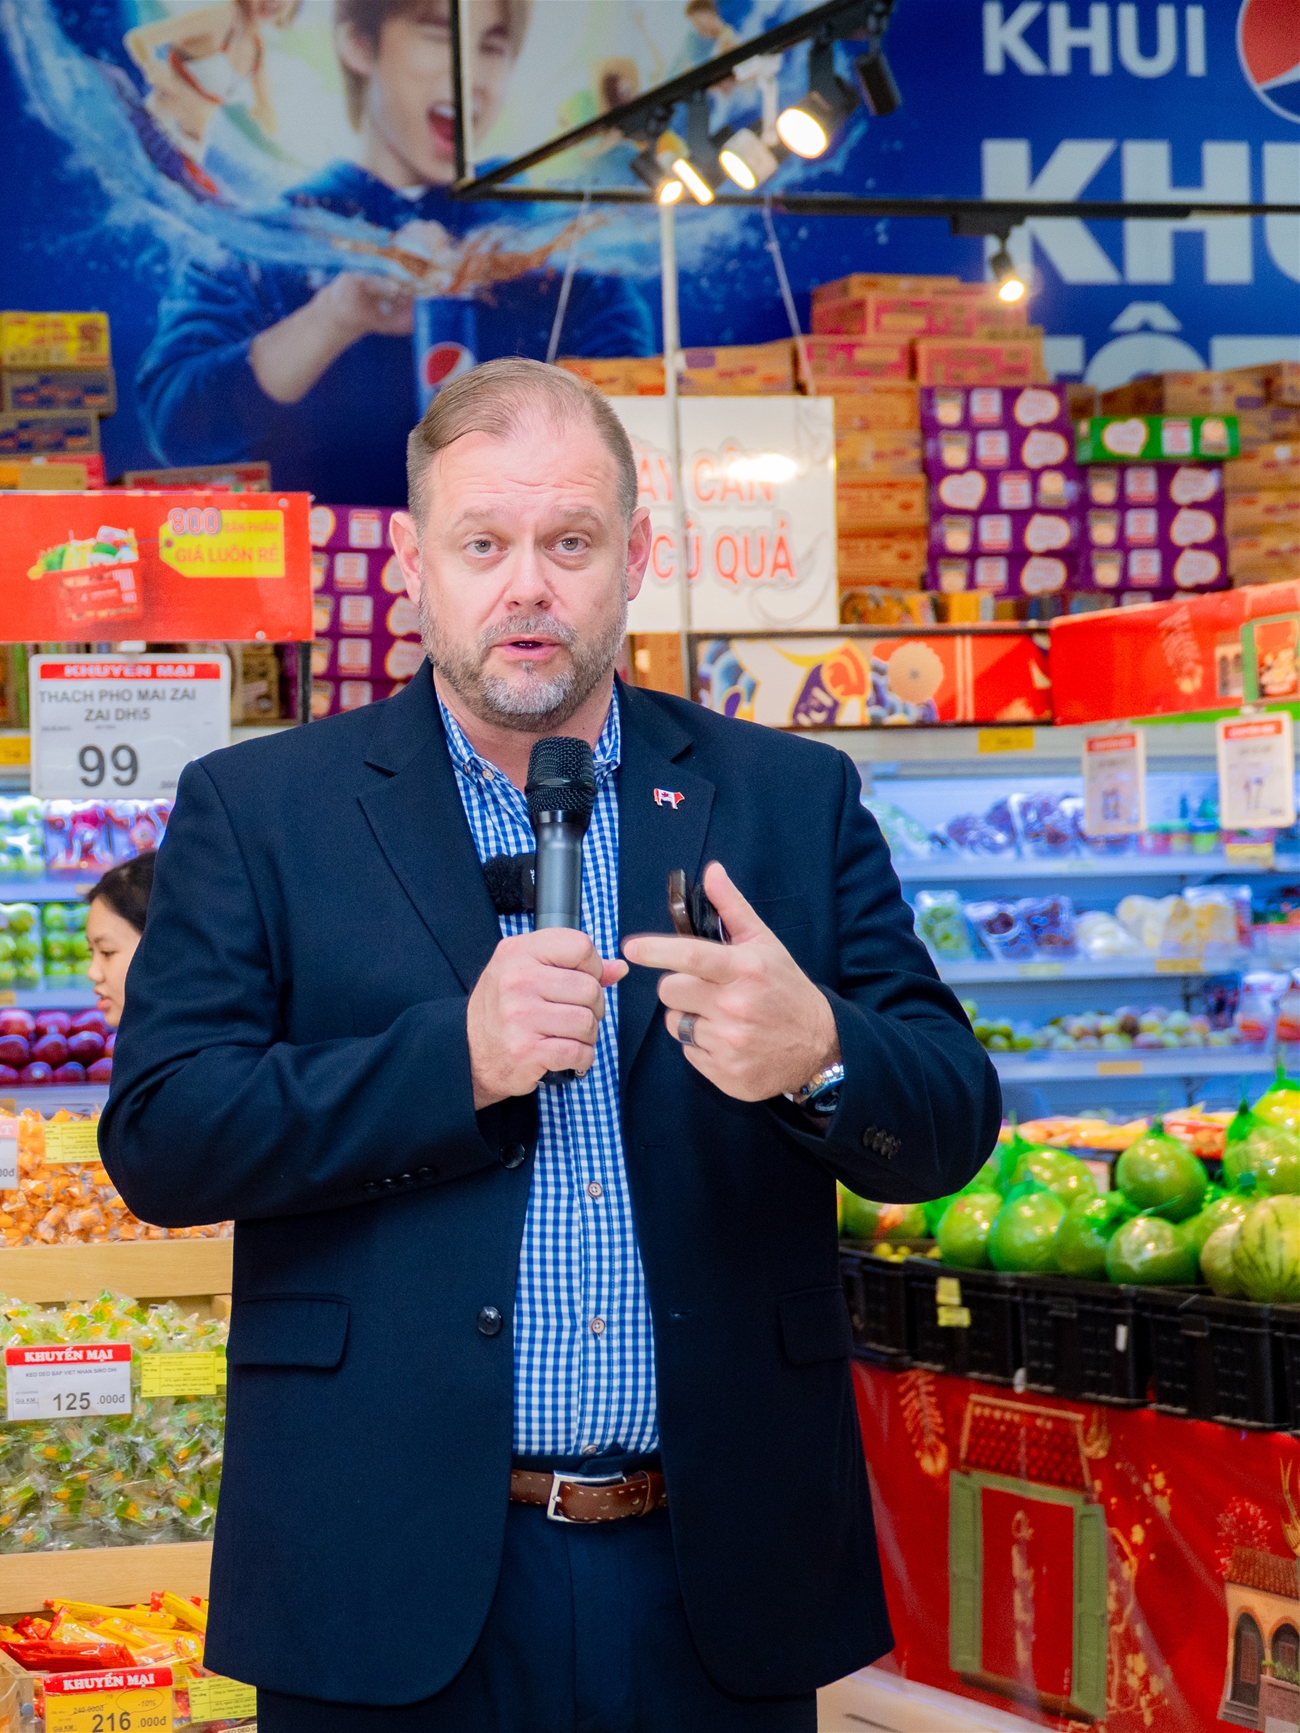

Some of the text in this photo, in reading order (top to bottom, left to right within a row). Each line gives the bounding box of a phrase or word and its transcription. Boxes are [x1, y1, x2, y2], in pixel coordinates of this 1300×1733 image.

[982, 3, 1207, 78] KHUI
[168, 507, 222, 536] 800
[174, 544, 205, 564] GIÁ
[208, 545, 254, 564] LUÔN
[714, 518, 796, 585] QUẢ
[39, 687, 197, 703] THACH PHO MAI ZAI
[84, 708, 111, 722] ZAI
[77, 743, 140, 788] 99
[24, 1347, 114, 1363] KHUYẾN MẠI
[52, 1391, 91, 1412] 125
[62, 1672, 155, 1690] KHUYẾN MẠI
[91, 1711, 131, 1733] 216
